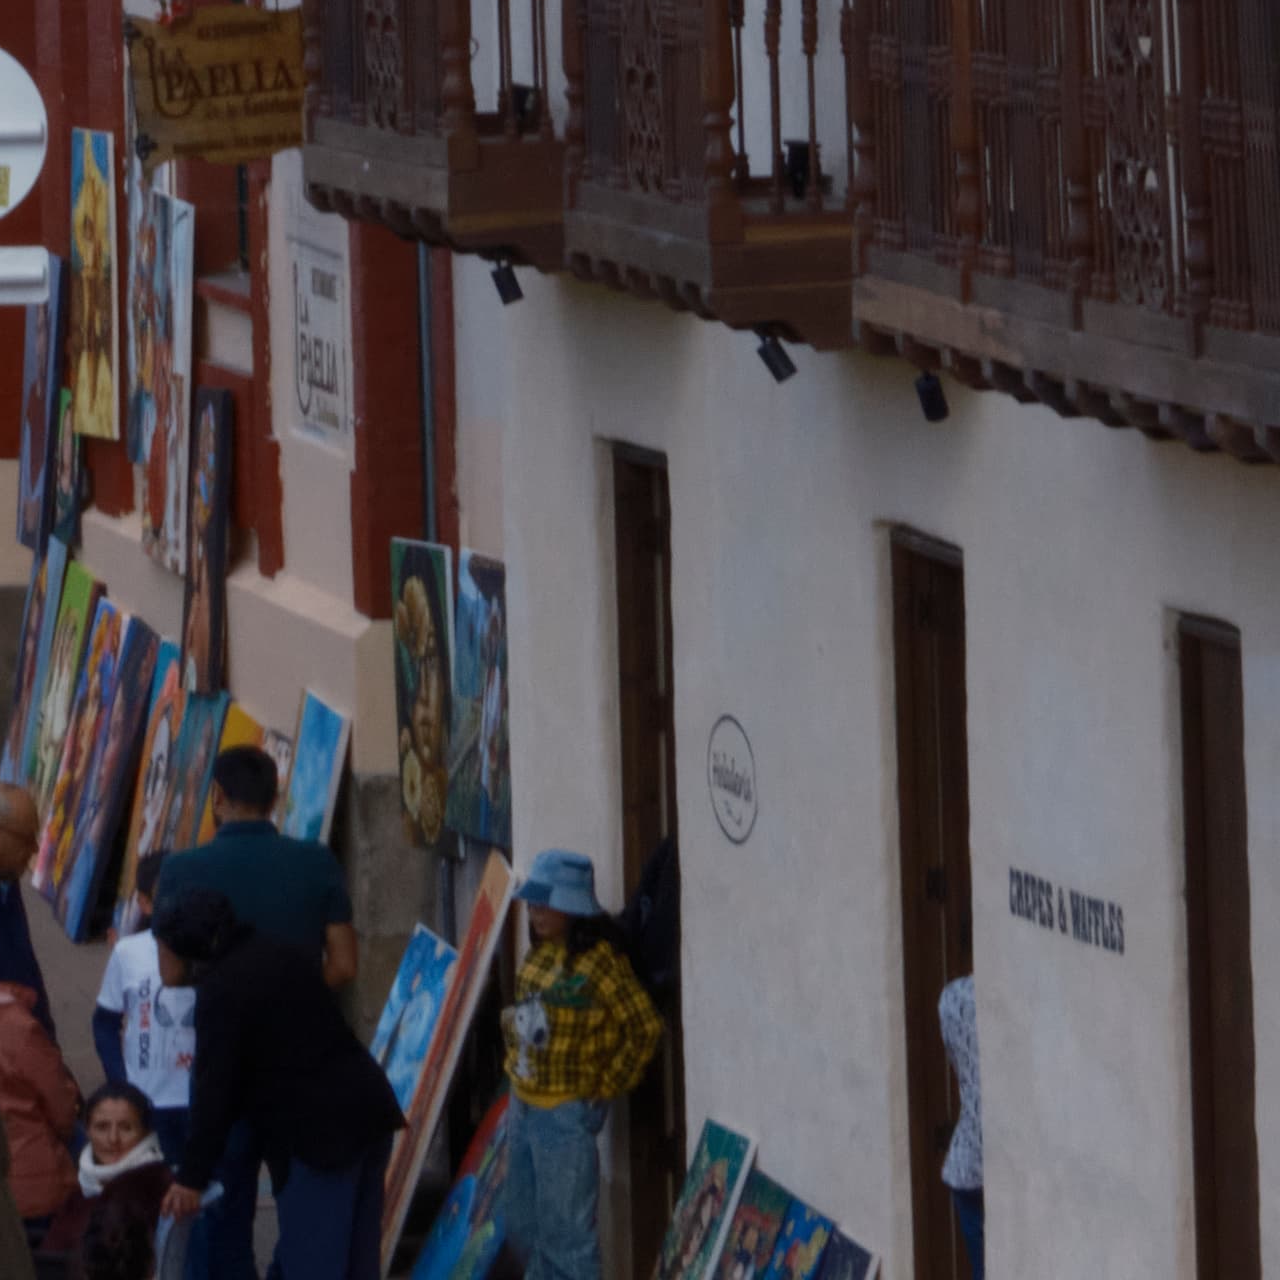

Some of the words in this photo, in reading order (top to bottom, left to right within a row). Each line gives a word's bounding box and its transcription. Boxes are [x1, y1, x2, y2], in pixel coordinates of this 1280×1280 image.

[164, 58, 297, 103] PAELLA
[1009, 866, 1054, 931] CREPES
[1057, 886, 1068, 935] &
[1069, 888, 1125, 955] WAFFLES
